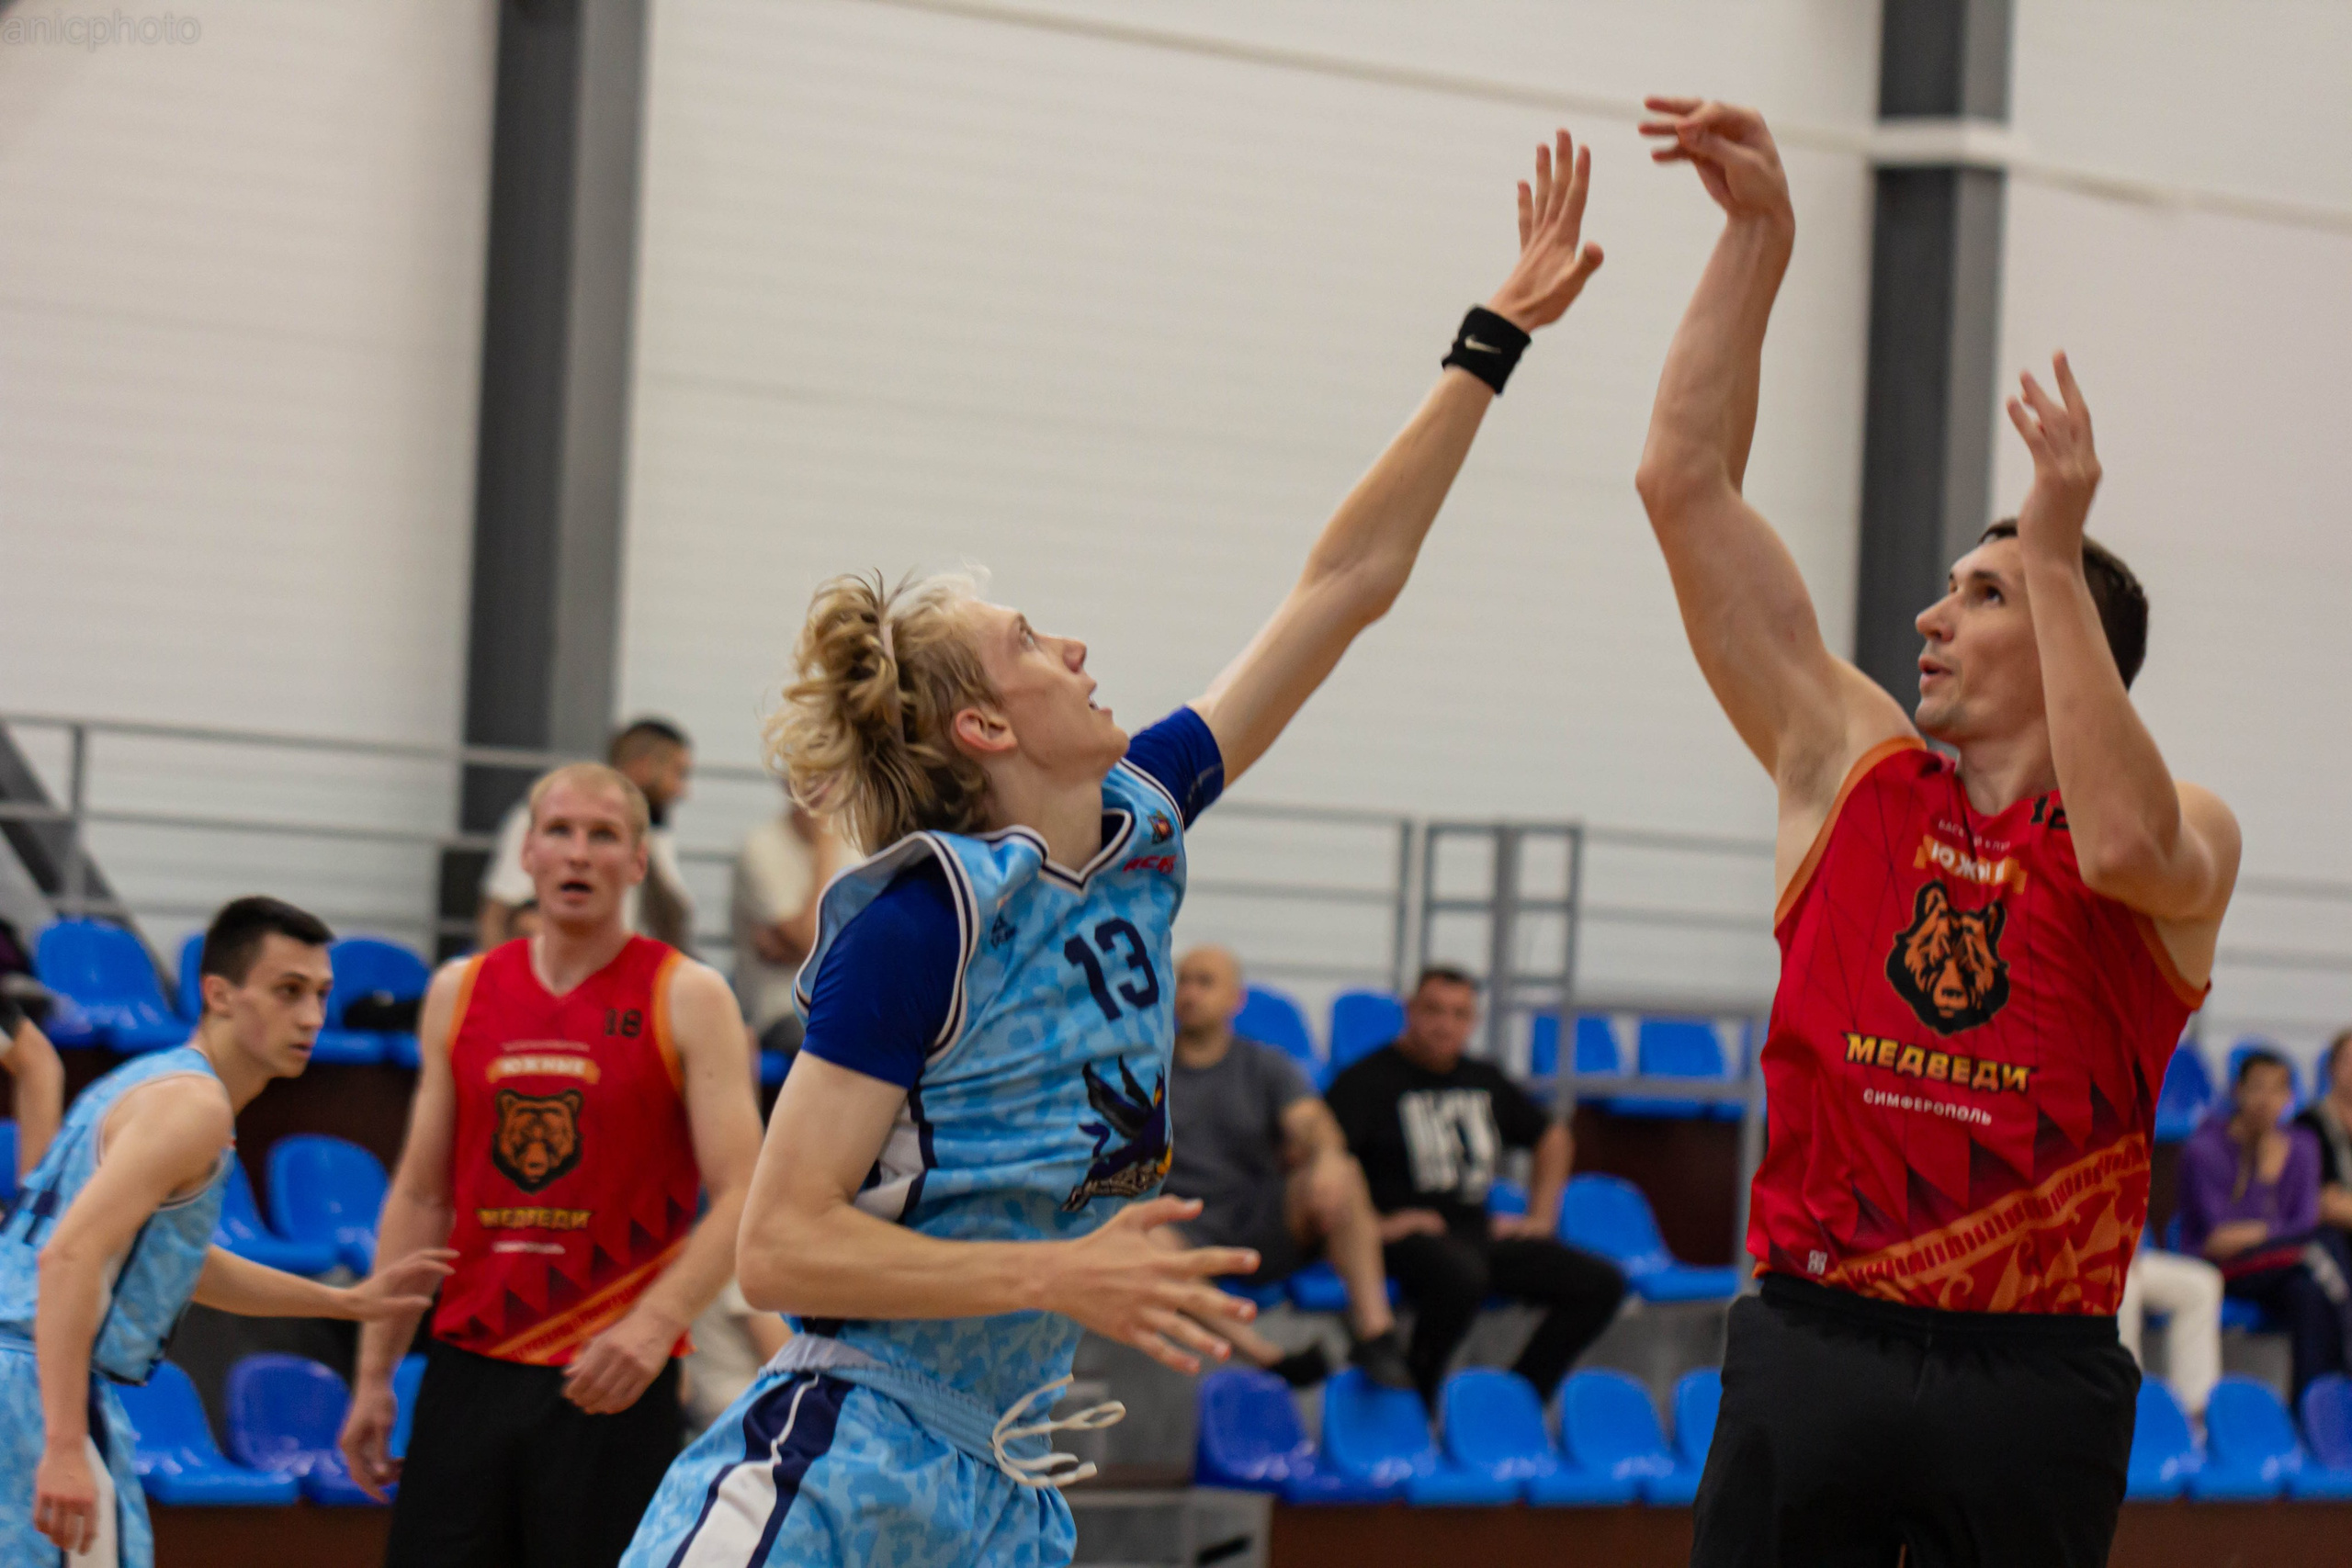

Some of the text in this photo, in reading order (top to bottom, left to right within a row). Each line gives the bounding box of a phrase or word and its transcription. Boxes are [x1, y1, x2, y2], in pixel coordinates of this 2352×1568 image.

[1063, 917, 1159, 1022] 13
[603, 1008, 643, 1038] 18
[1844, 1031, 2033, 1093] МЕДВЕДИ
[1862, 1087, 1993, 1127] СИМФЕРОПОЛЬ
